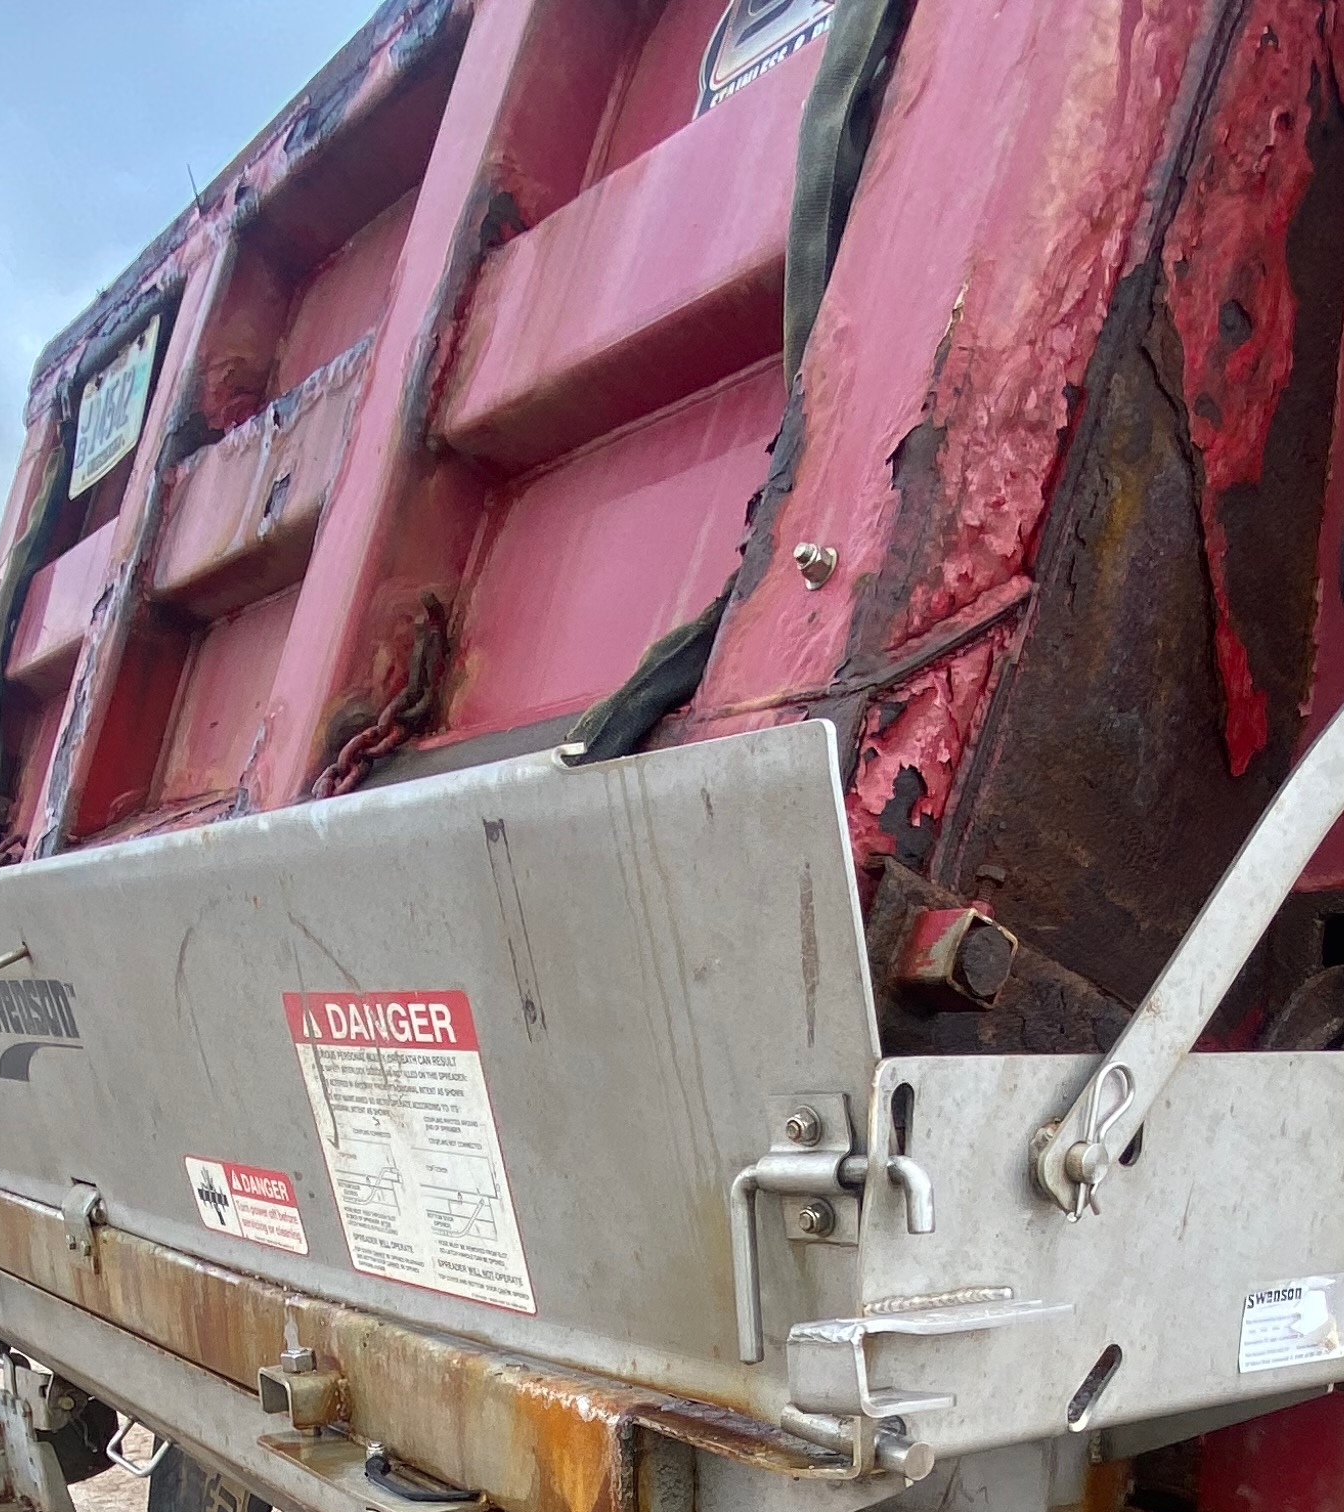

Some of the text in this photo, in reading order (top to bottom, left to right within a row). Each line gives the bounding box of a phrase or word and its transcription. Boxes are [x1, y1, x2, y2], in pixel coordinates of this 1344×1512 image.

[325, 1003, 457, 1043] DANGER
[431, 1056, 457, 1066] RESULT
[240, 1174, 289, 1201] DANGER
